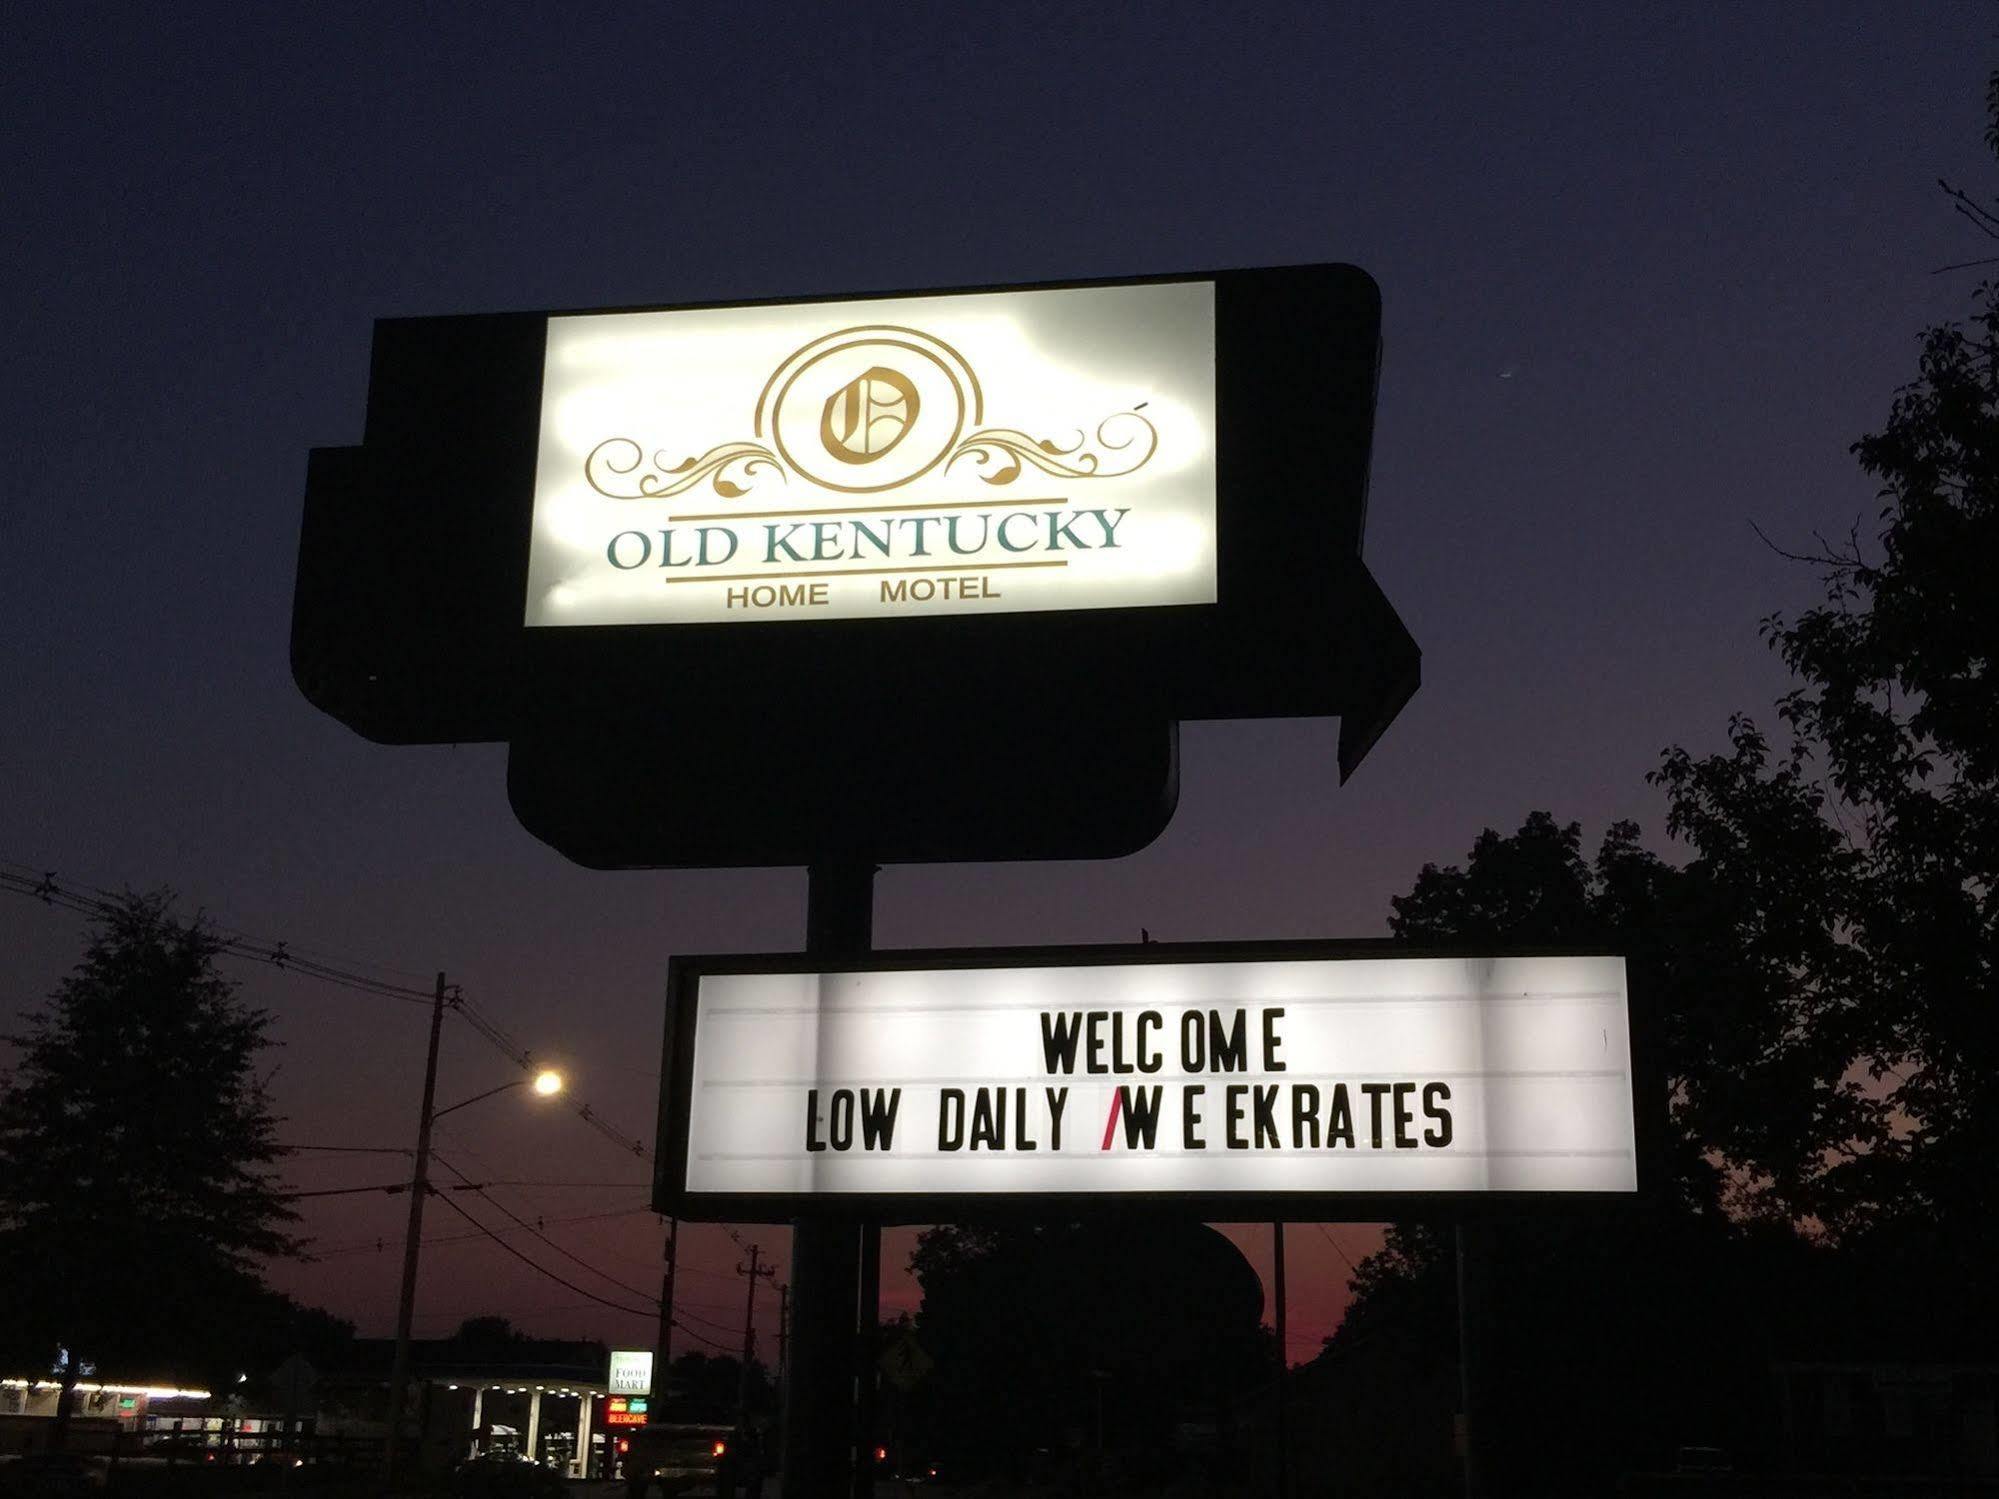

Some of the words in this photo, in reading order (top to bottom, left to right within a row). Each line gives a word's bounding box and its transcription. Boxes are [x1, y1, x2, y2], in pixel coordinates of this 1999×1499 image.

[606, 526, 739, 571] OLD
[761, 507, 1132, 565] KENTUCKY
[725, 583, 831, 610] HOME
[879, 576, 1002, 604] MOTEL
[805, 1087, 903, 1153] LOW
[937, 1085, 1070, 1153] DAILY
[615, 1380, 645, 1391] MART
[616, 1367, 647, 1379] FOOD
